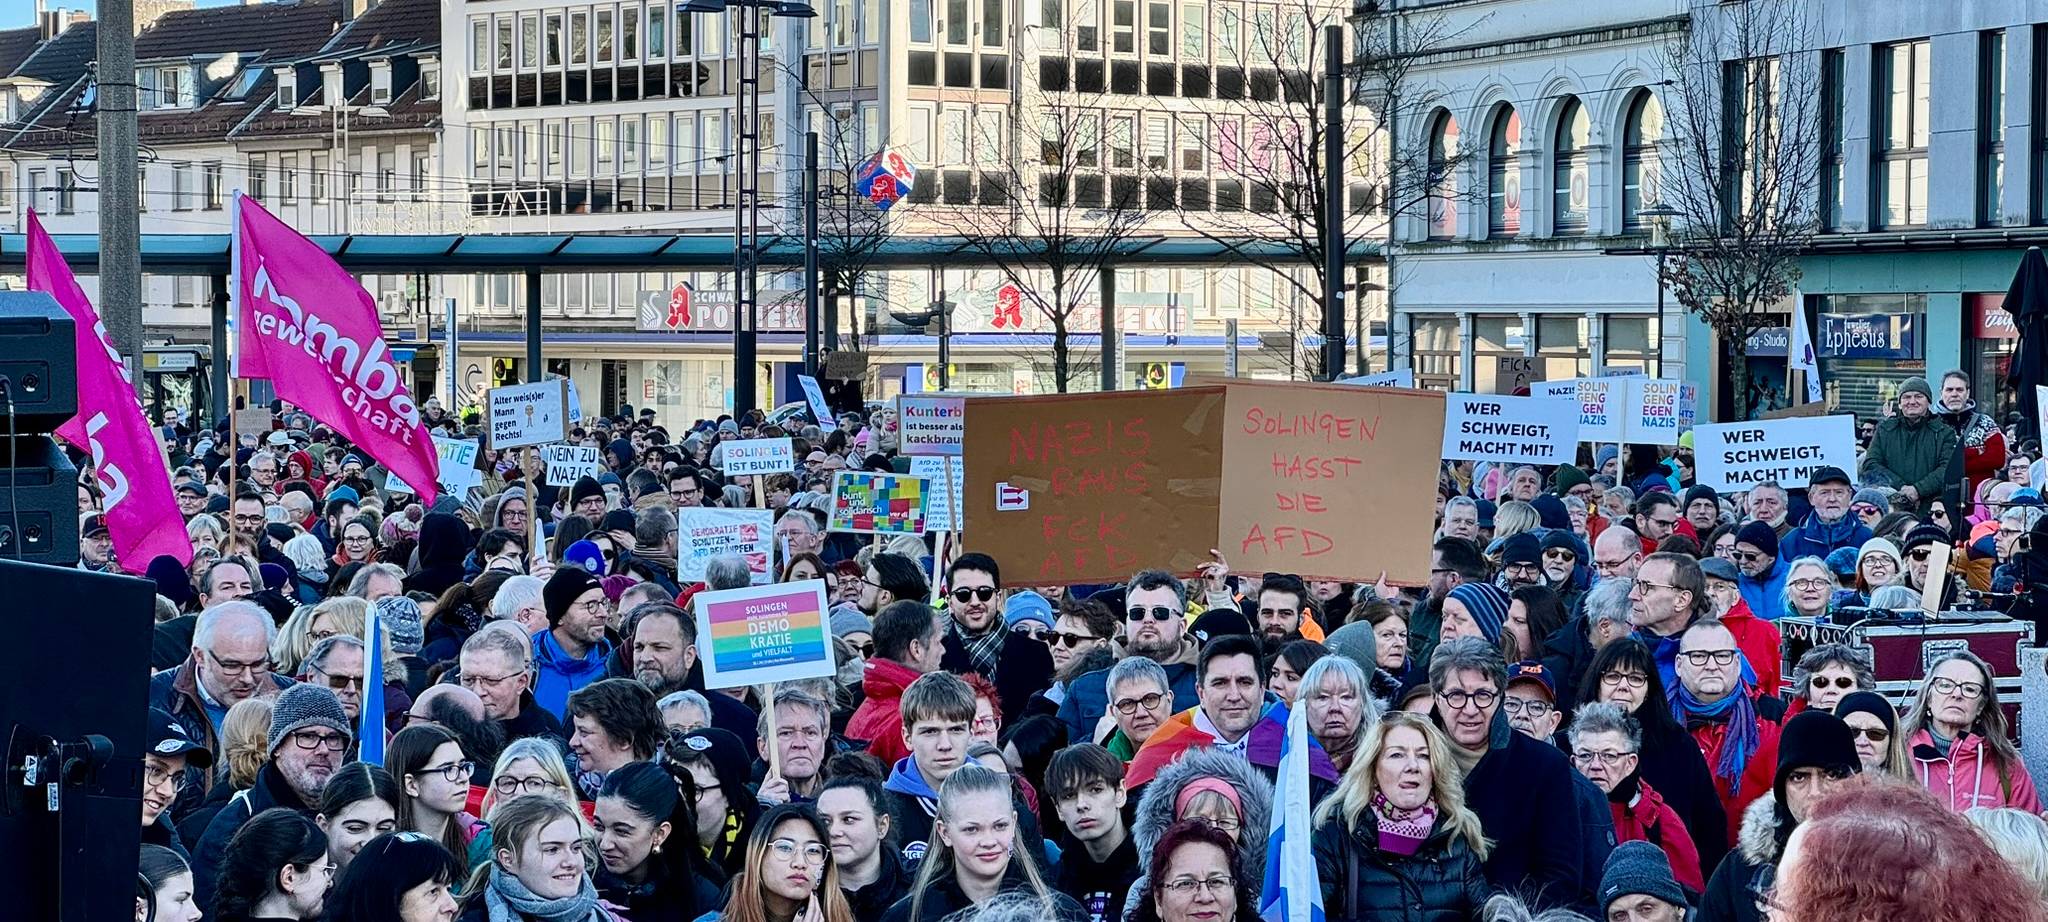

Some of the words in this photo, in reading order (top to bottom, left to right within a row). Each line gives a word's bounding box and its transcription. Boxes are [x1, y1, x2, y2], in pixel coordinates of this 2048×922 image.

[1763, 333, 1787, 347] Studio
[1825, 319, 1886, 355] Ephesus
[1577, 381, 1609, 392] SOLIN
[1643, 383, 1678, 394] SOLIN
[494, 396, 512, 405] Alter
[513, 391, 545, 403] weis(s)er
[1577, 393, 1606, 403] GENG
[1643, 395, 1674, 405] GENG
[494, 408, 515, 417] Mann
[906, 407, 962, 417] Kunterb
[1463, 402, 1501, 416] WER
[1580, 403, 1604, 414] GEN
[1642, 406, 1673, 416] EGEN
[494, 420, 517, 431] gegen
[906, 422, 917, 430] ist
[919, 423, 949, 431] besser
[1243, 407, 1382, 444] SOLINGEN
[1641, 417, 1676, 428] NAZIS
[495, 430, 522, 441] Rechts!
[1461, 421, 1551, 440] SCHWEIGT,
[906, 434, 961, 444] kackbrau
[1009, 416, 1152, 465] NAZIS
[1722, 430, 1765, 444] WER
[550, 447, 575, 462] NEIN
[580, 448, 596, 463] ZU
[728, 446, 788, 457] SOLINGEN
[1459, 441, 1517, 455] MACHT
[1520, 443, 1554, 457] MIT!
[1724, 445, 1825, 464] SCHWEIGT,
[729, 462, 747, 471] IST
[750, 460, 783, 470] BUNT
[1272, 451, 1363, 481] HASST
[1725, 467, 1789, 484] MACHT
[842, 492, 862, 500] bunt
[849, 497, 866, 507] und
[1275, 492, 1328, 512] DIE
[1242, 523, 1334, 556] AFD
[745, 602, 788, 615] SOLINGEN
[748, 618, 790, 635] DEMO
[750, 633, 792, 649] KRATIE
[763, 645, 793, 657] VIELFALT
